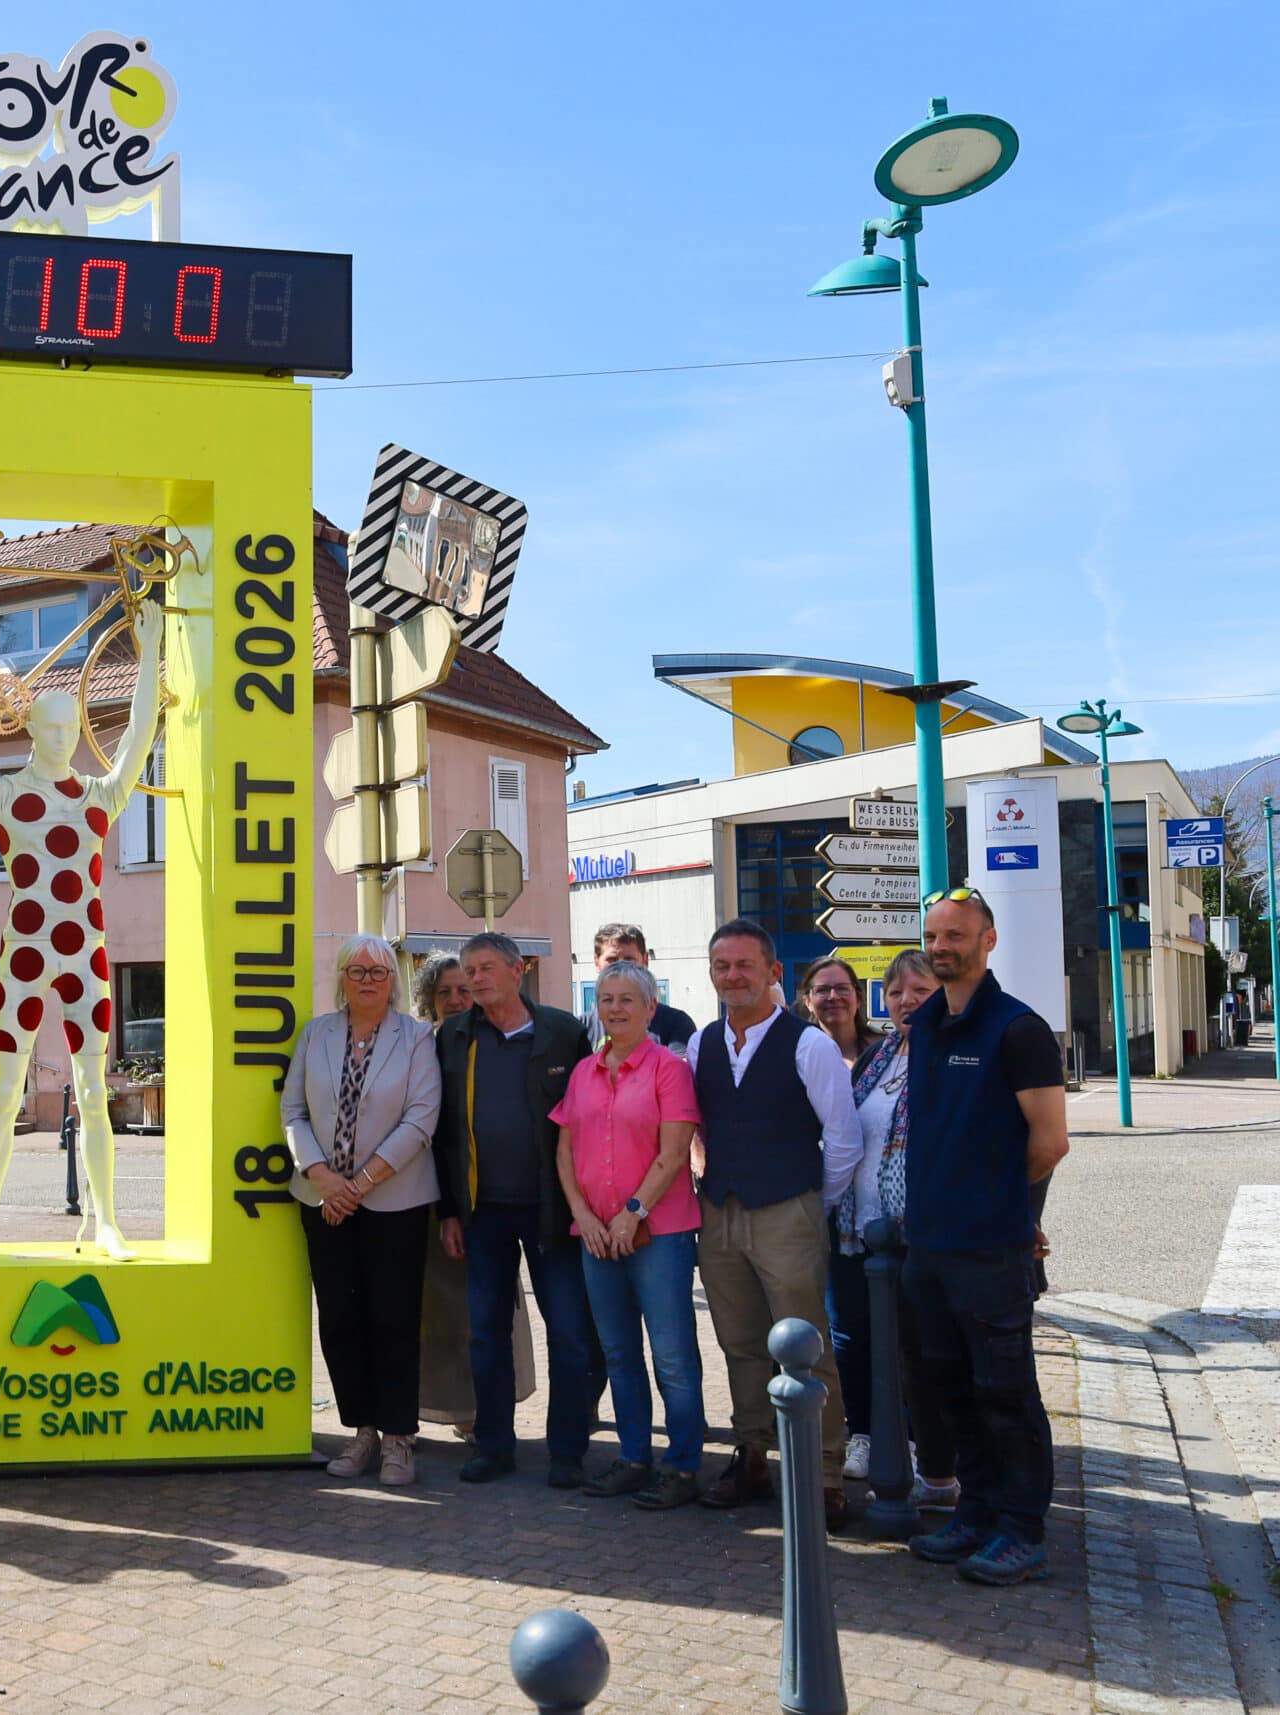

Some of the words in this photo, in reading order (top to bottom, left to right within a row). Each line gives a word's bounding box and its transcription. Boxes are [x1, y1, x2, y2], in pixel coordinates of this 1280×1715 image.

[78, 110, 121, 151] de
[235, 533, 296, 715] 2026
[858, 817, 873, 826] Col
[876, 817, 887, 826] de
[889, 818, 919, 828] BUSS
[850, 841, 860, 850] du
[863, 841, 916, 852] Firmenweiher
[887, 853, 916, 864] Tennis
[1200, 848, 1217, 865] P
[576, 849, 630, 882] Mutuel
[839, 889, 867, 899] Centre
[870, 890, 881, 899] de
[884, 890, 917, 900] Secours
[874, 878, 917, 889] Pompiers
[234, 761, 297, 1092] JUILLET
[856, 914, 878, 924] Gare
[234, 1144, 296, 1219] 18
[144, 1361, 296, 1396] d'Alsace
[40, 1409, 128, 1437] SAINT
[148, 1406, 265, 1434] AMARIN
